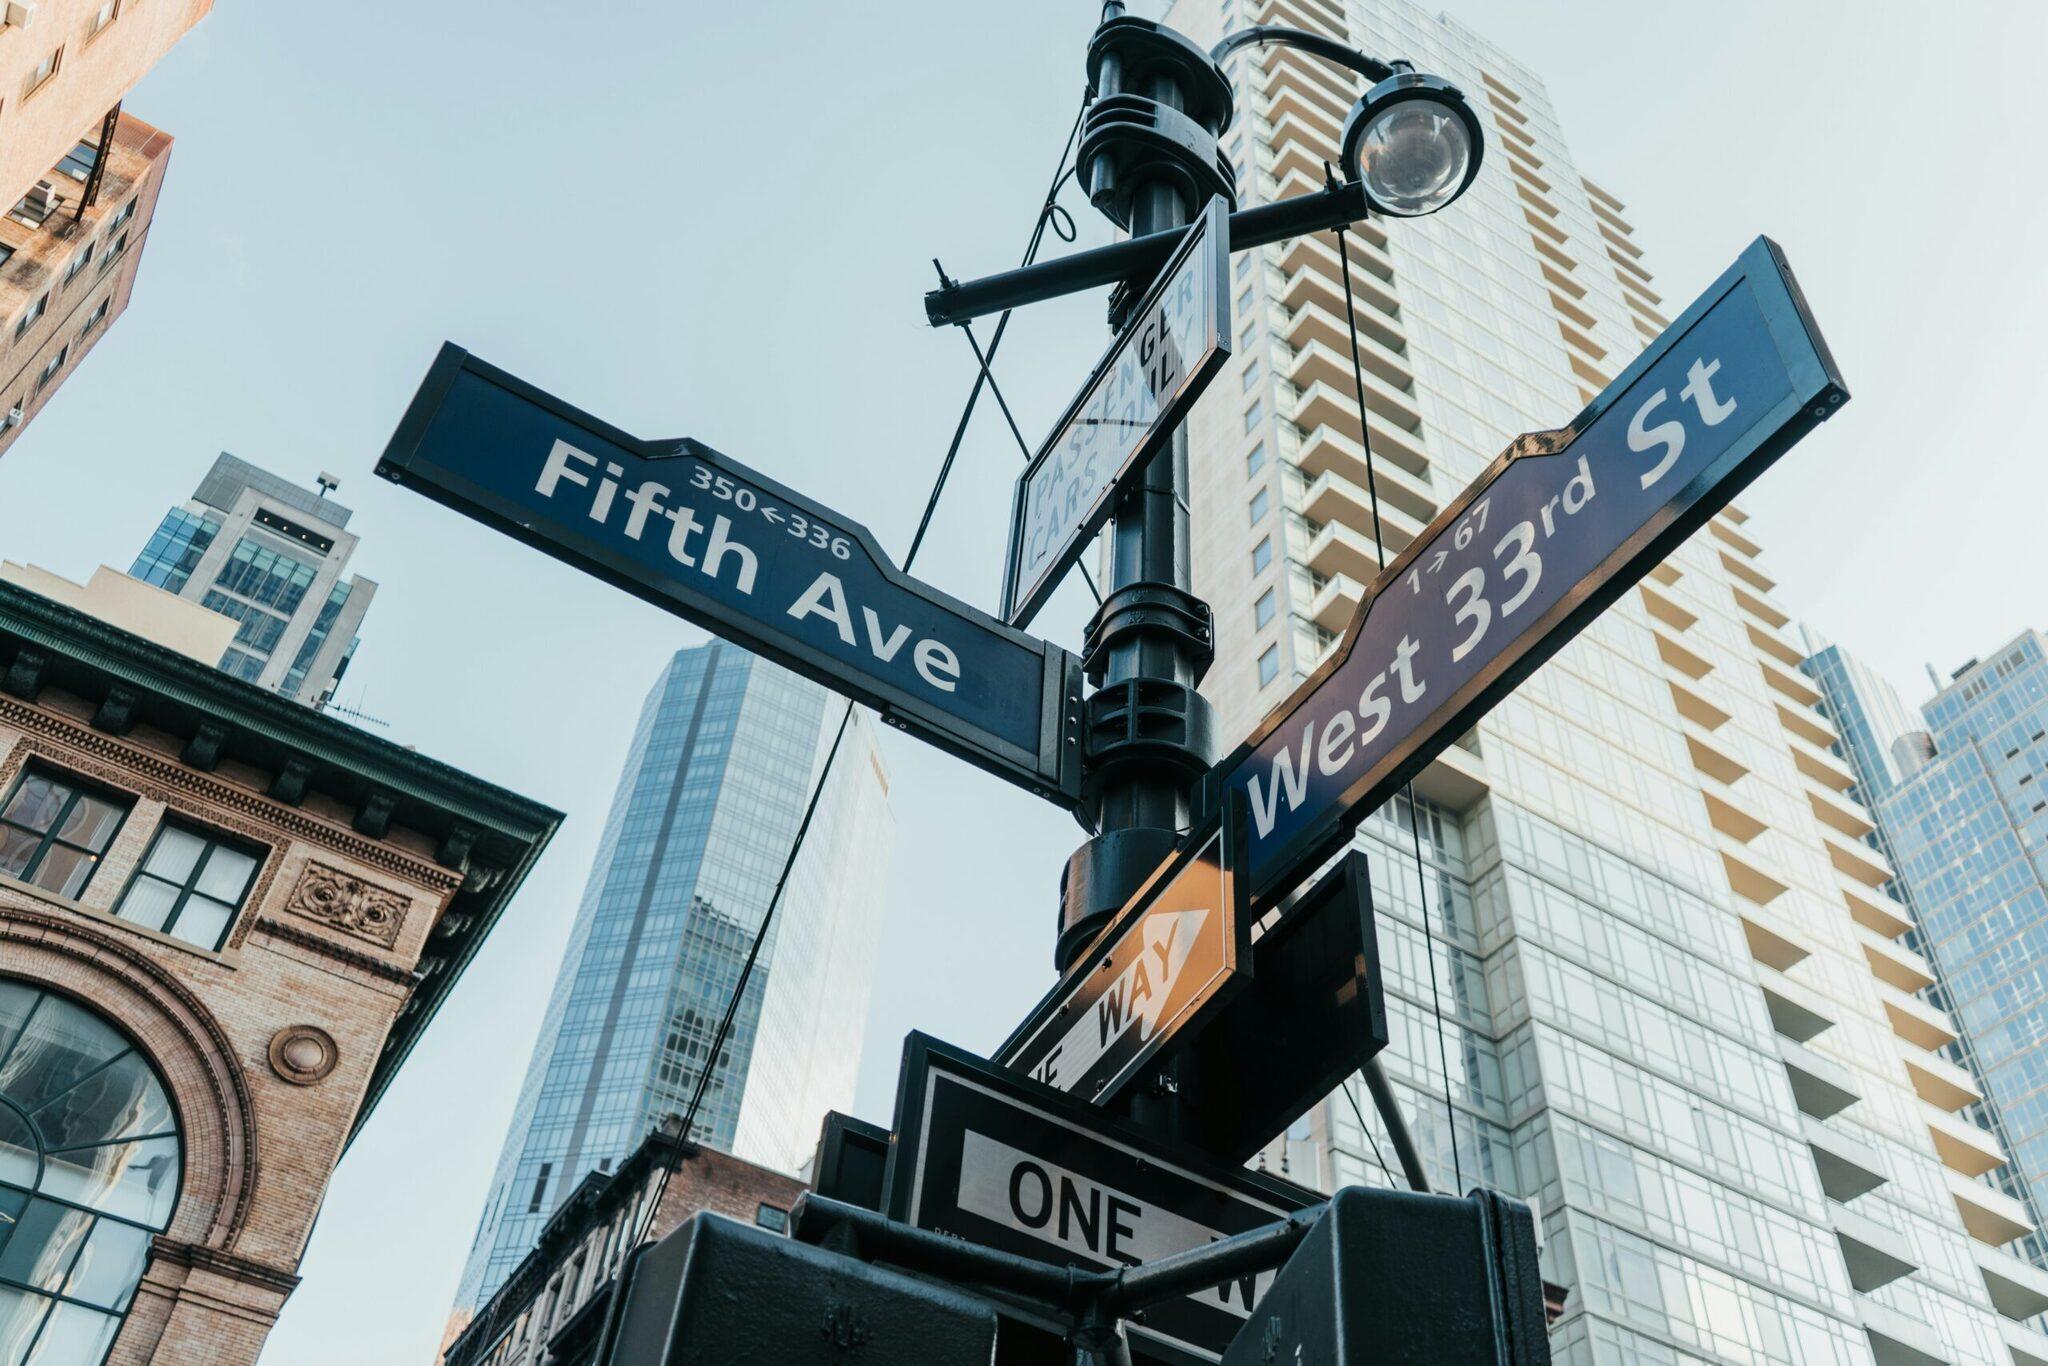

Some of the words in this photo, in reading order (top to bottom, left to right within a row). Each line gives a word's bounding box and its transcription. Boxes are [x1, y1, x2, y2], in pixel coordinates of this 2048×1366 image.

[1029, 451, 1098, 571] CARS
[1119, 313, 1193, 447] ONLY
[1035, 270, 1194, 519] PASSENGER
[534, 438, 759, 595] Fifth
[786, 571, 961, 693] Ave
[689, 465, 757, 513] 350
[786, 513, 852, 561] 336
[1247, 633, 1427, 841] West
[1446, 454, 1596, 664] 33rd
[1626, 357, 1739, 491] St
[1454, 497, 1492, 551] 67
[1098, 917, 1180, 1050] WAY
[1009, 1160, 1142, 1267] ONE
